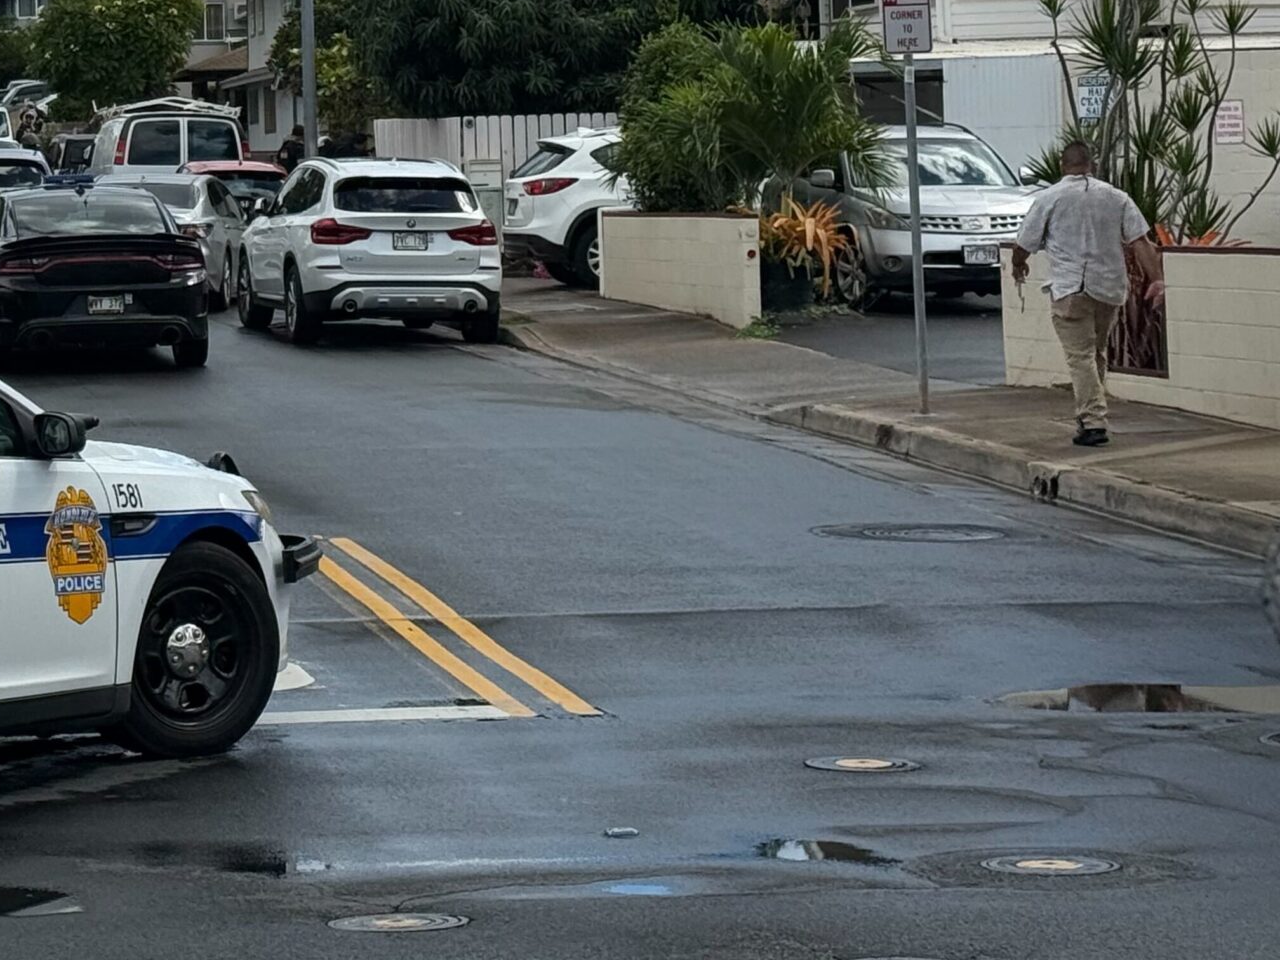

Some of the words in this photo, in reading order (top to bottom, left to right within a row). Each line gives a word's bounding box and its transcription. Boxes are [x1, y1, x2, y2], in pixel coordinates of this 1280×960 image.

[890, 10, 923, 21] CORNER
[897, 37, 919, 48] HERE
[112, 483, 143, 508] 1581
[57, 576, 102, 592] POLICE
